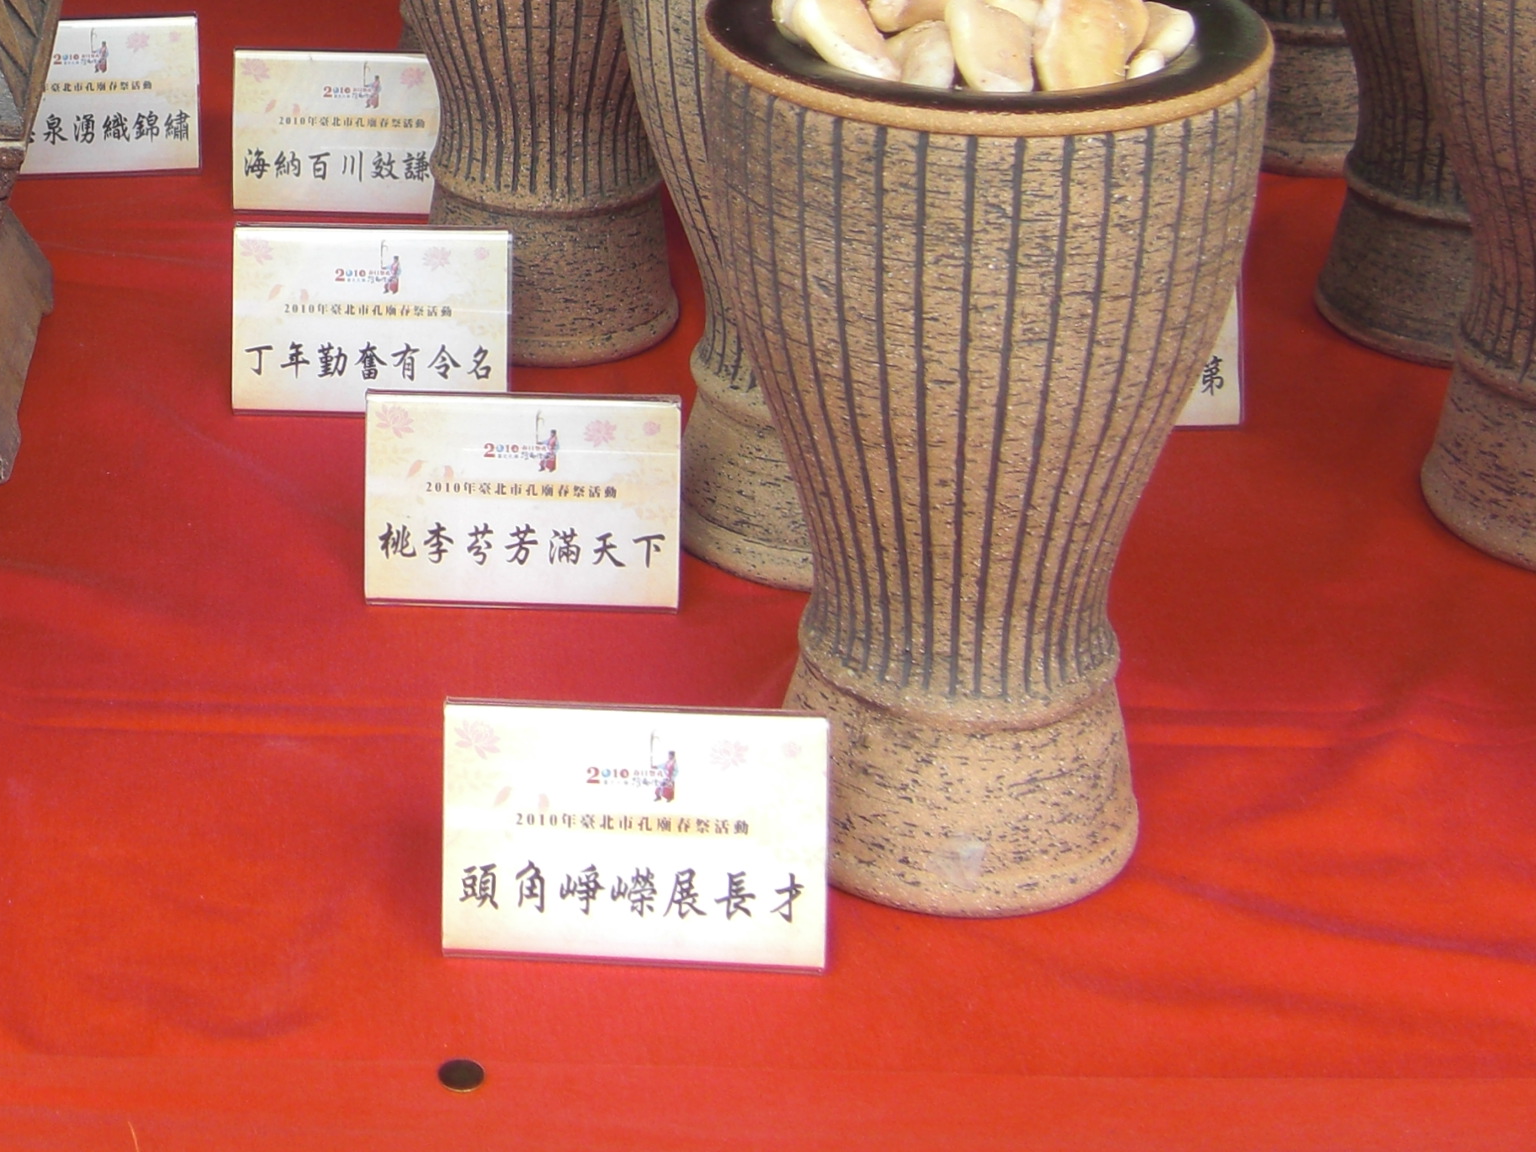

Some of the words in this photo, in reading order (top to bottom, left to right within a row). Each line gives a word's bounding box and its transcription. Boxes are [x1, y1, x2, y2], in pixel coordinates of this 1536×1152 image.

[28, 109, 190, 146] 泉湧織錦繡
[244, 341, 493, 381] 丁年勤奮有令名
[378, 521, 666, 569] 桃李芬芳滿天下
[458, 860, 805, 924] 頭角崢嶸展長才
